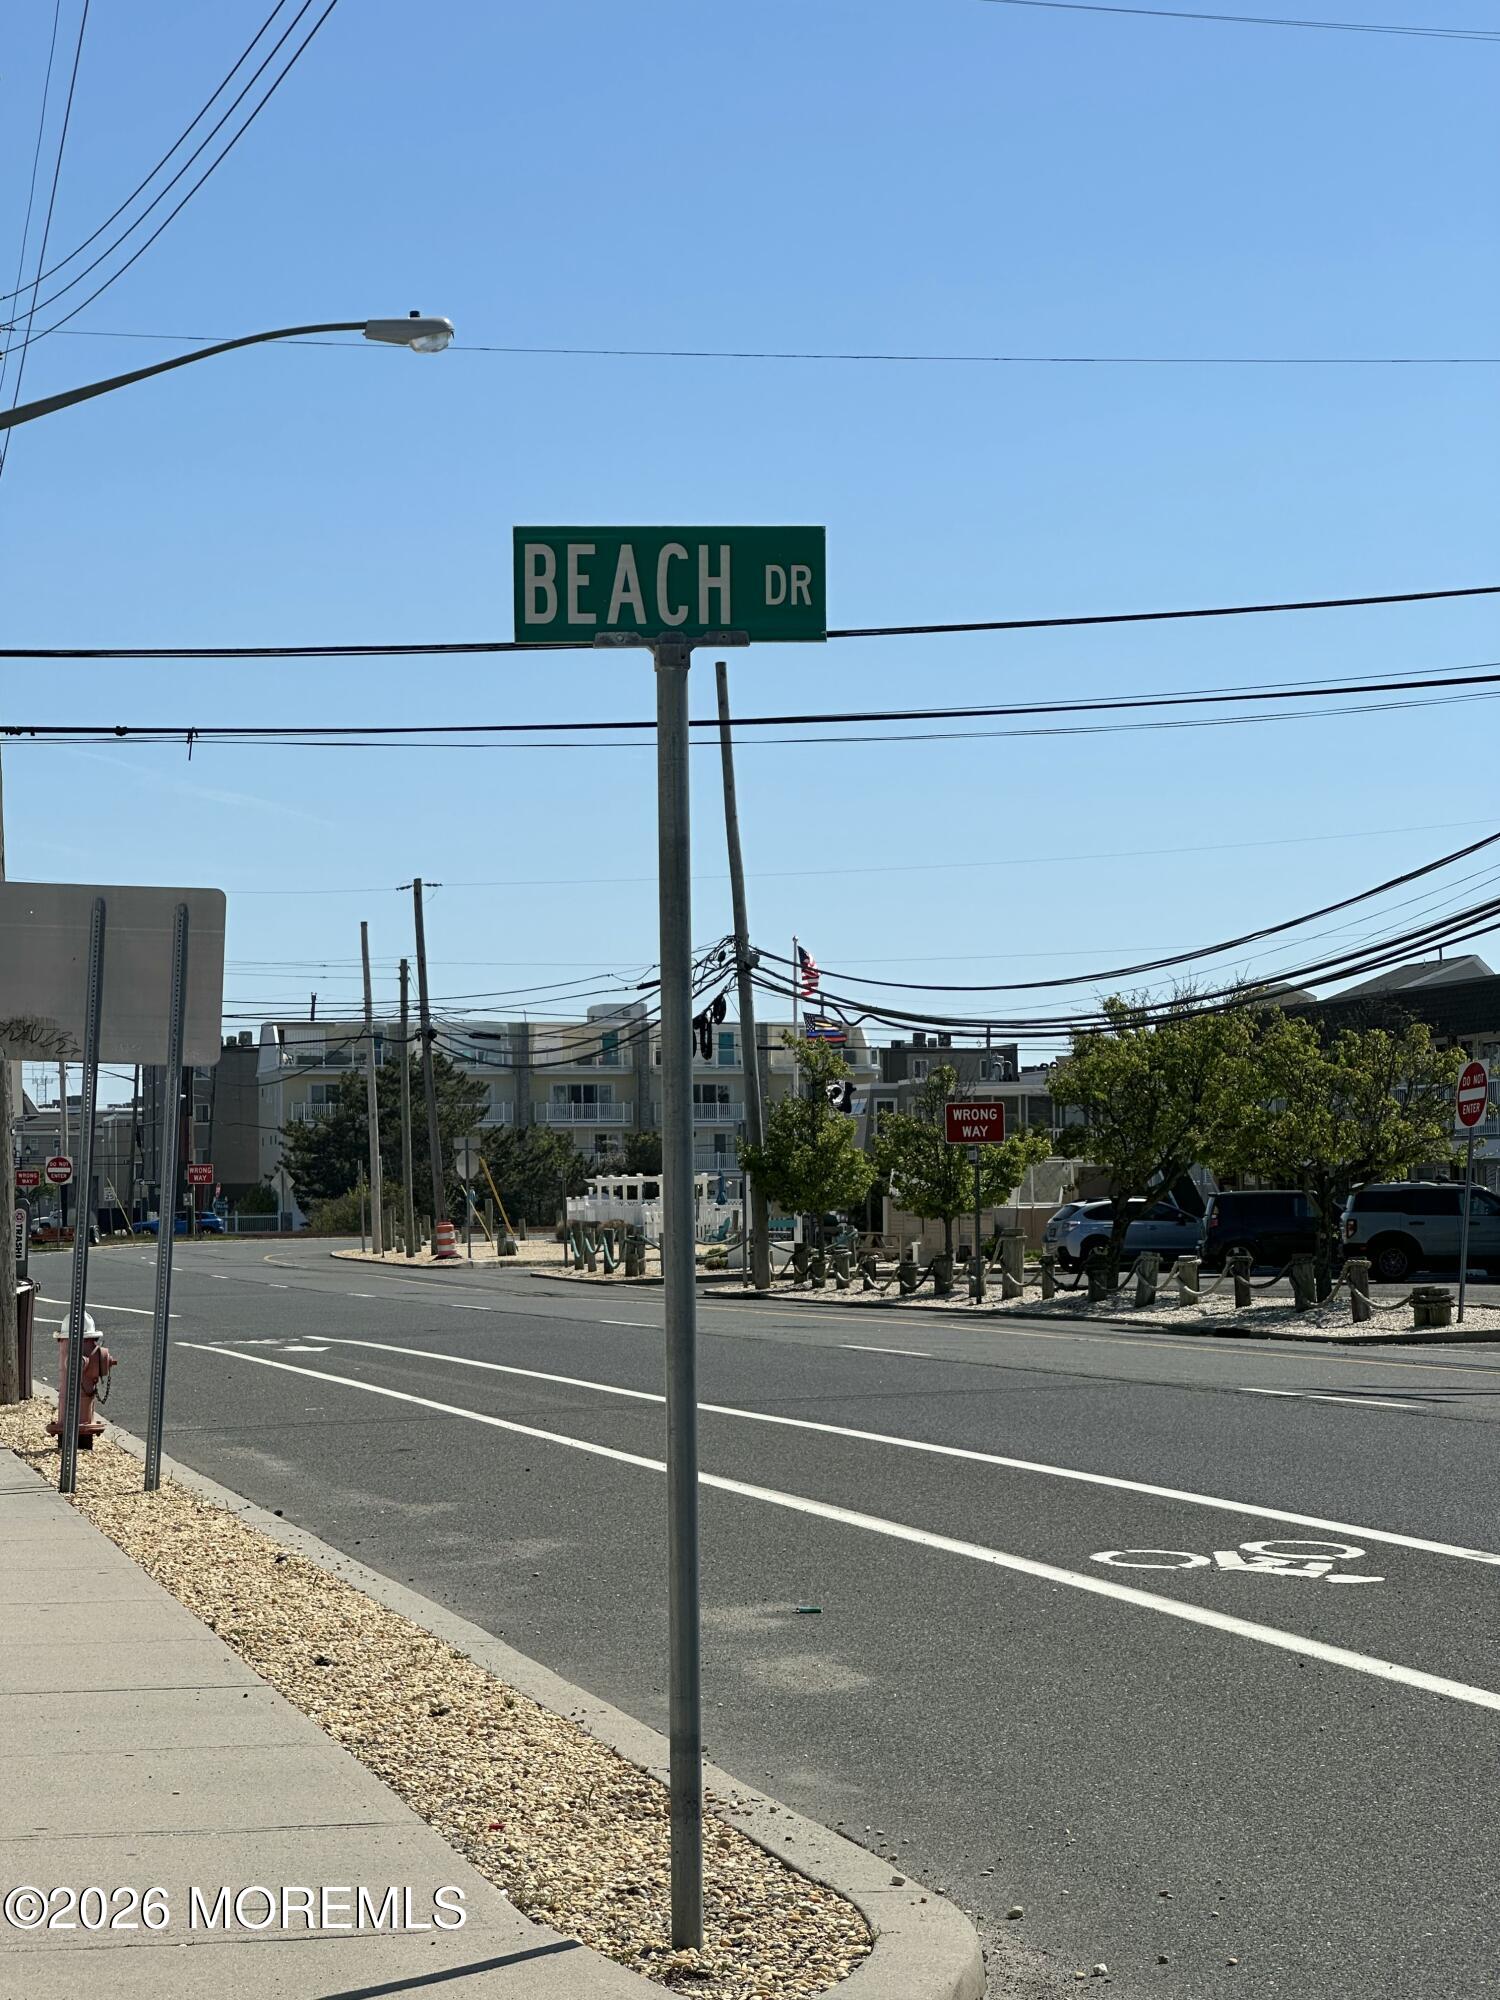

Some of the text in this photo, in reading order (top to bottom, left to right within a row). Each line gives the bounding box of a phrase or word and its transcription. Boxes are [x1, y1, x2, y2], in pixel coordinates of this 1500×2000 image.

[524, 542, 812, 626] BEACH DR
[1463, 1074, 1484, 1087] DO NOT
[953, 1109, 997, 1120] WRONG
[1463, 1103, 1480, 1115] ENTER
[962, 1126, 988, 1137] WAY
